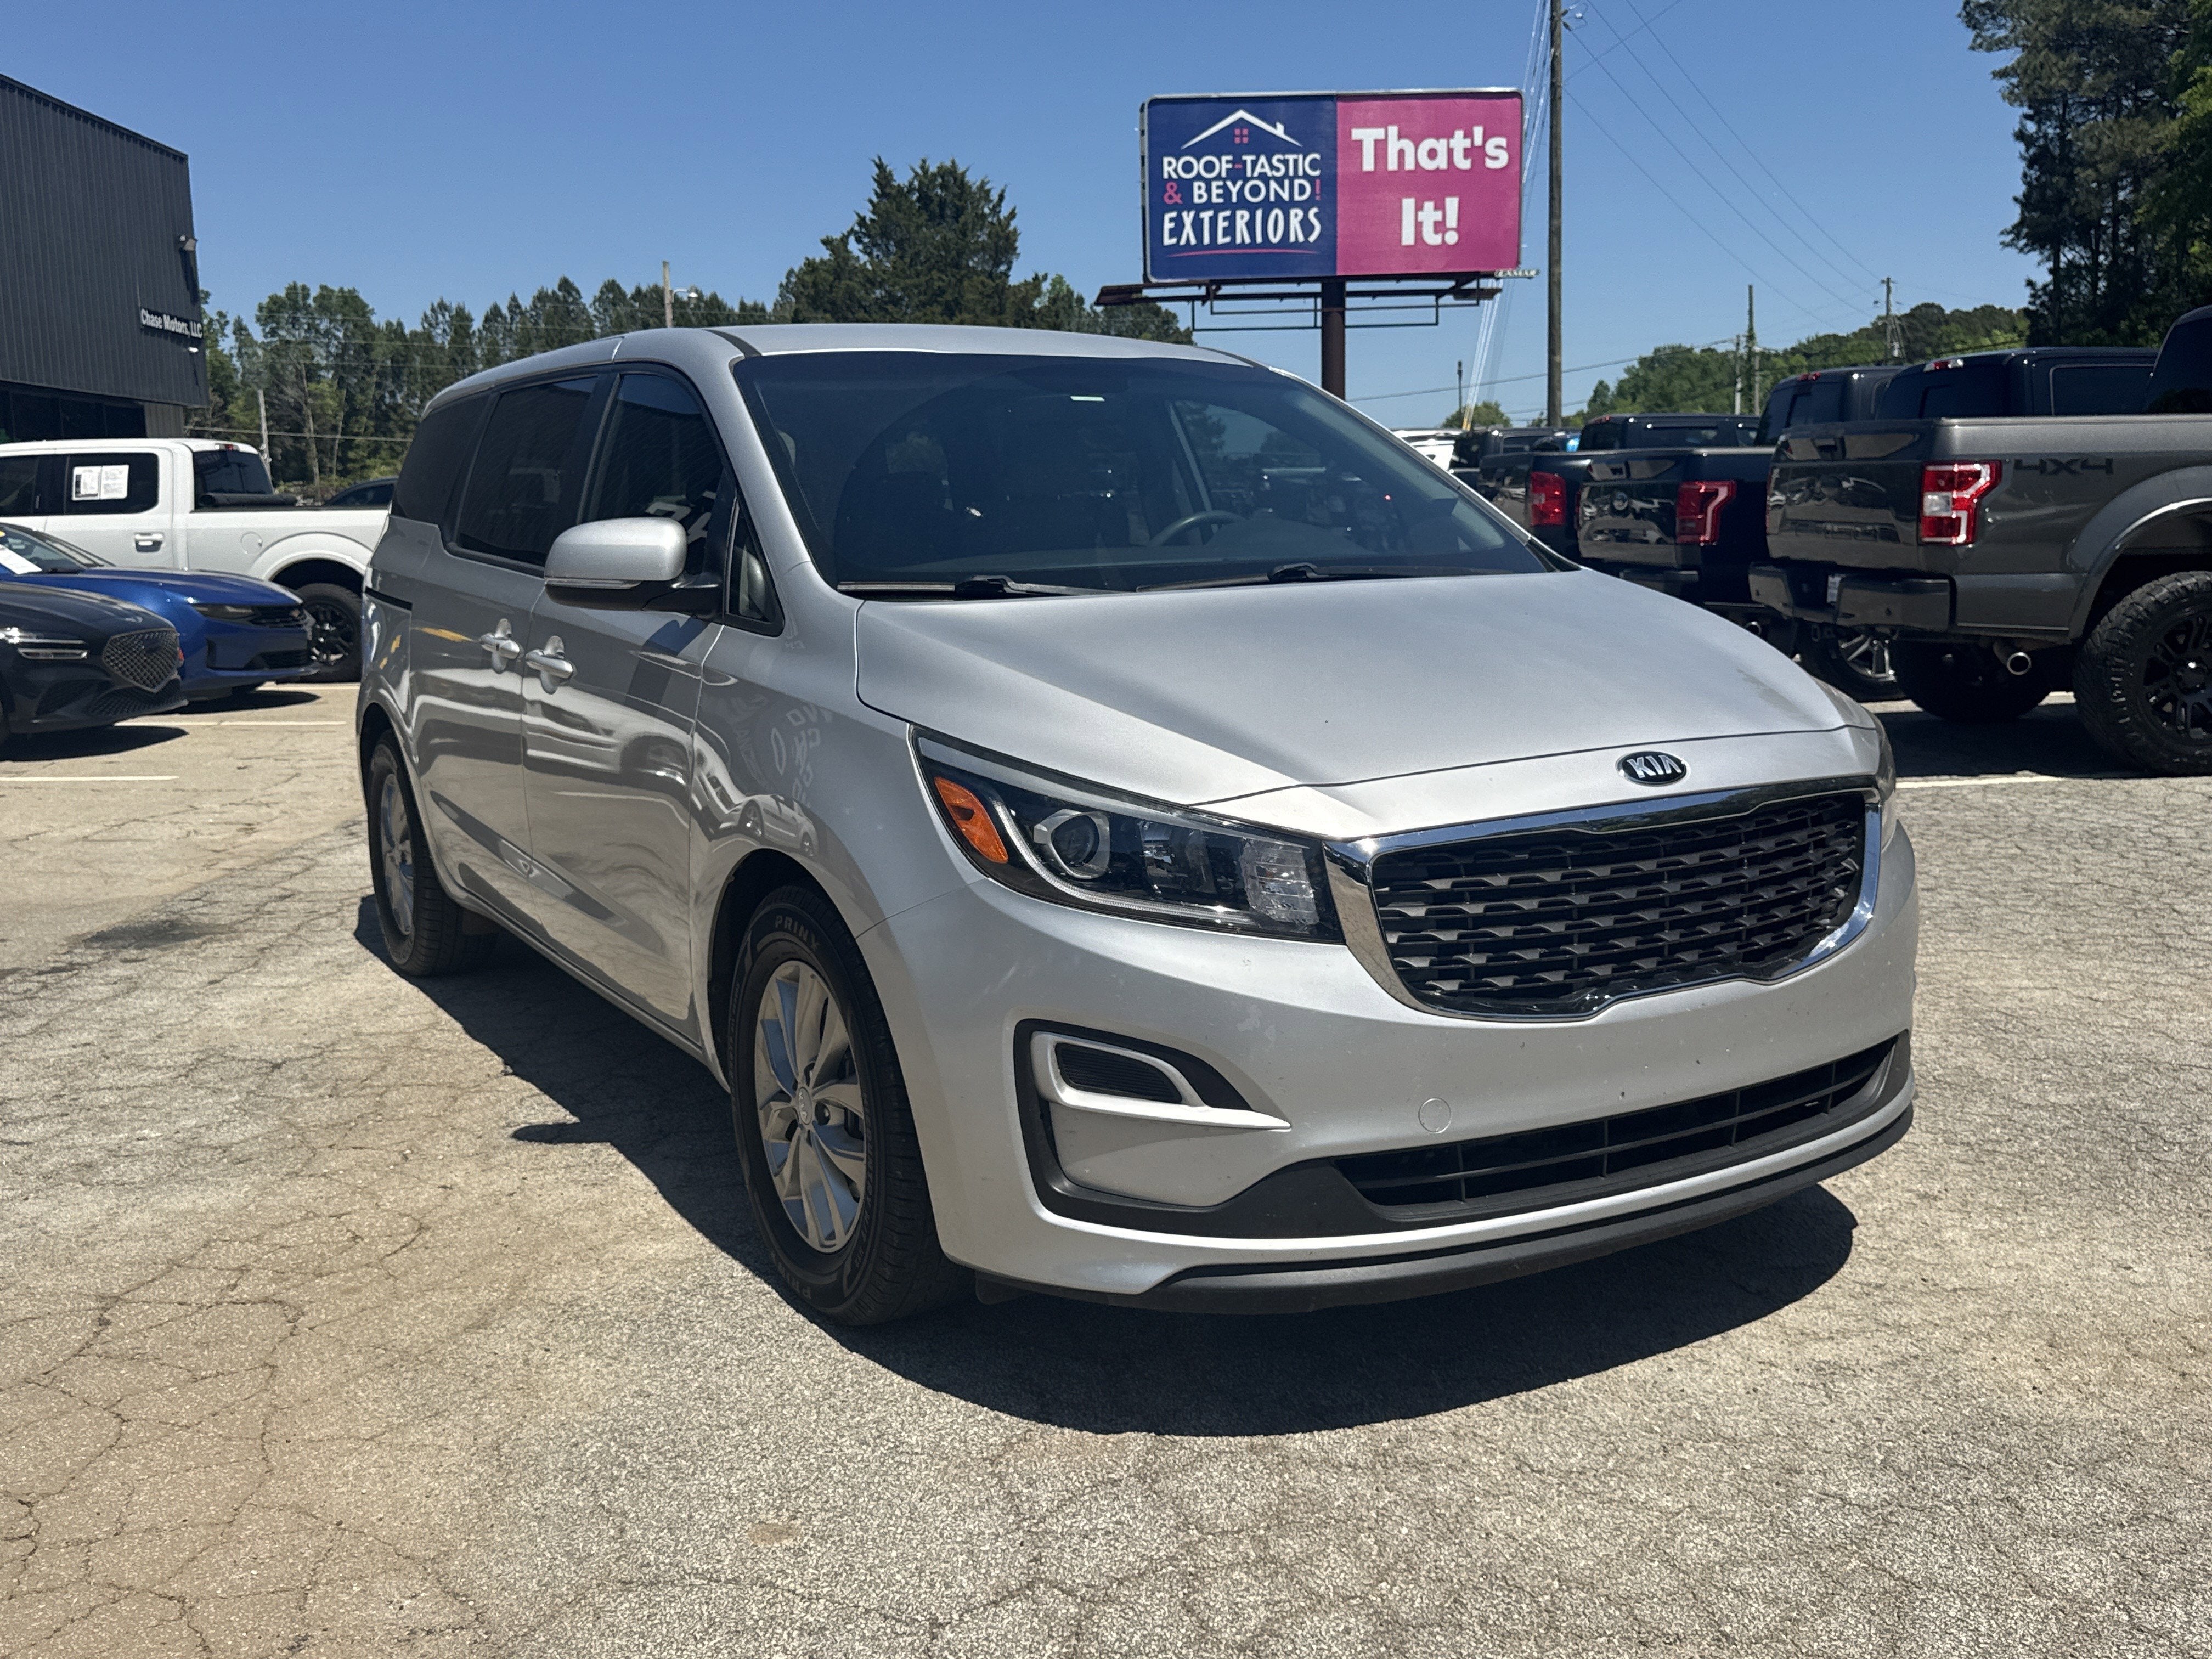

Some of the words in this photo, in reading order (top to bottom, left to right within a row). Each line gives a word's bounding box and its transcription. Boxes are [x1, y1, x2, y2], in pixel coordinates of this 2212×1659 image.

[1351, 125, 1509, 172] That's
[1162, 153, 1321, 179] ROOF-TASTIC
[1163, 182, 1183, 204] &
[1192, 178, 1321, 204] BEYOND!
[1162, 206, 1322, 246] EXTERIORS
[1401, 196, 1459, 246] It!
[141, 308, 163, 329] Chase
[163, 313, 190, 338] Motors,
[190, 321, 202, 338] LLC
[1626, 754, 1682, 778] KIA
